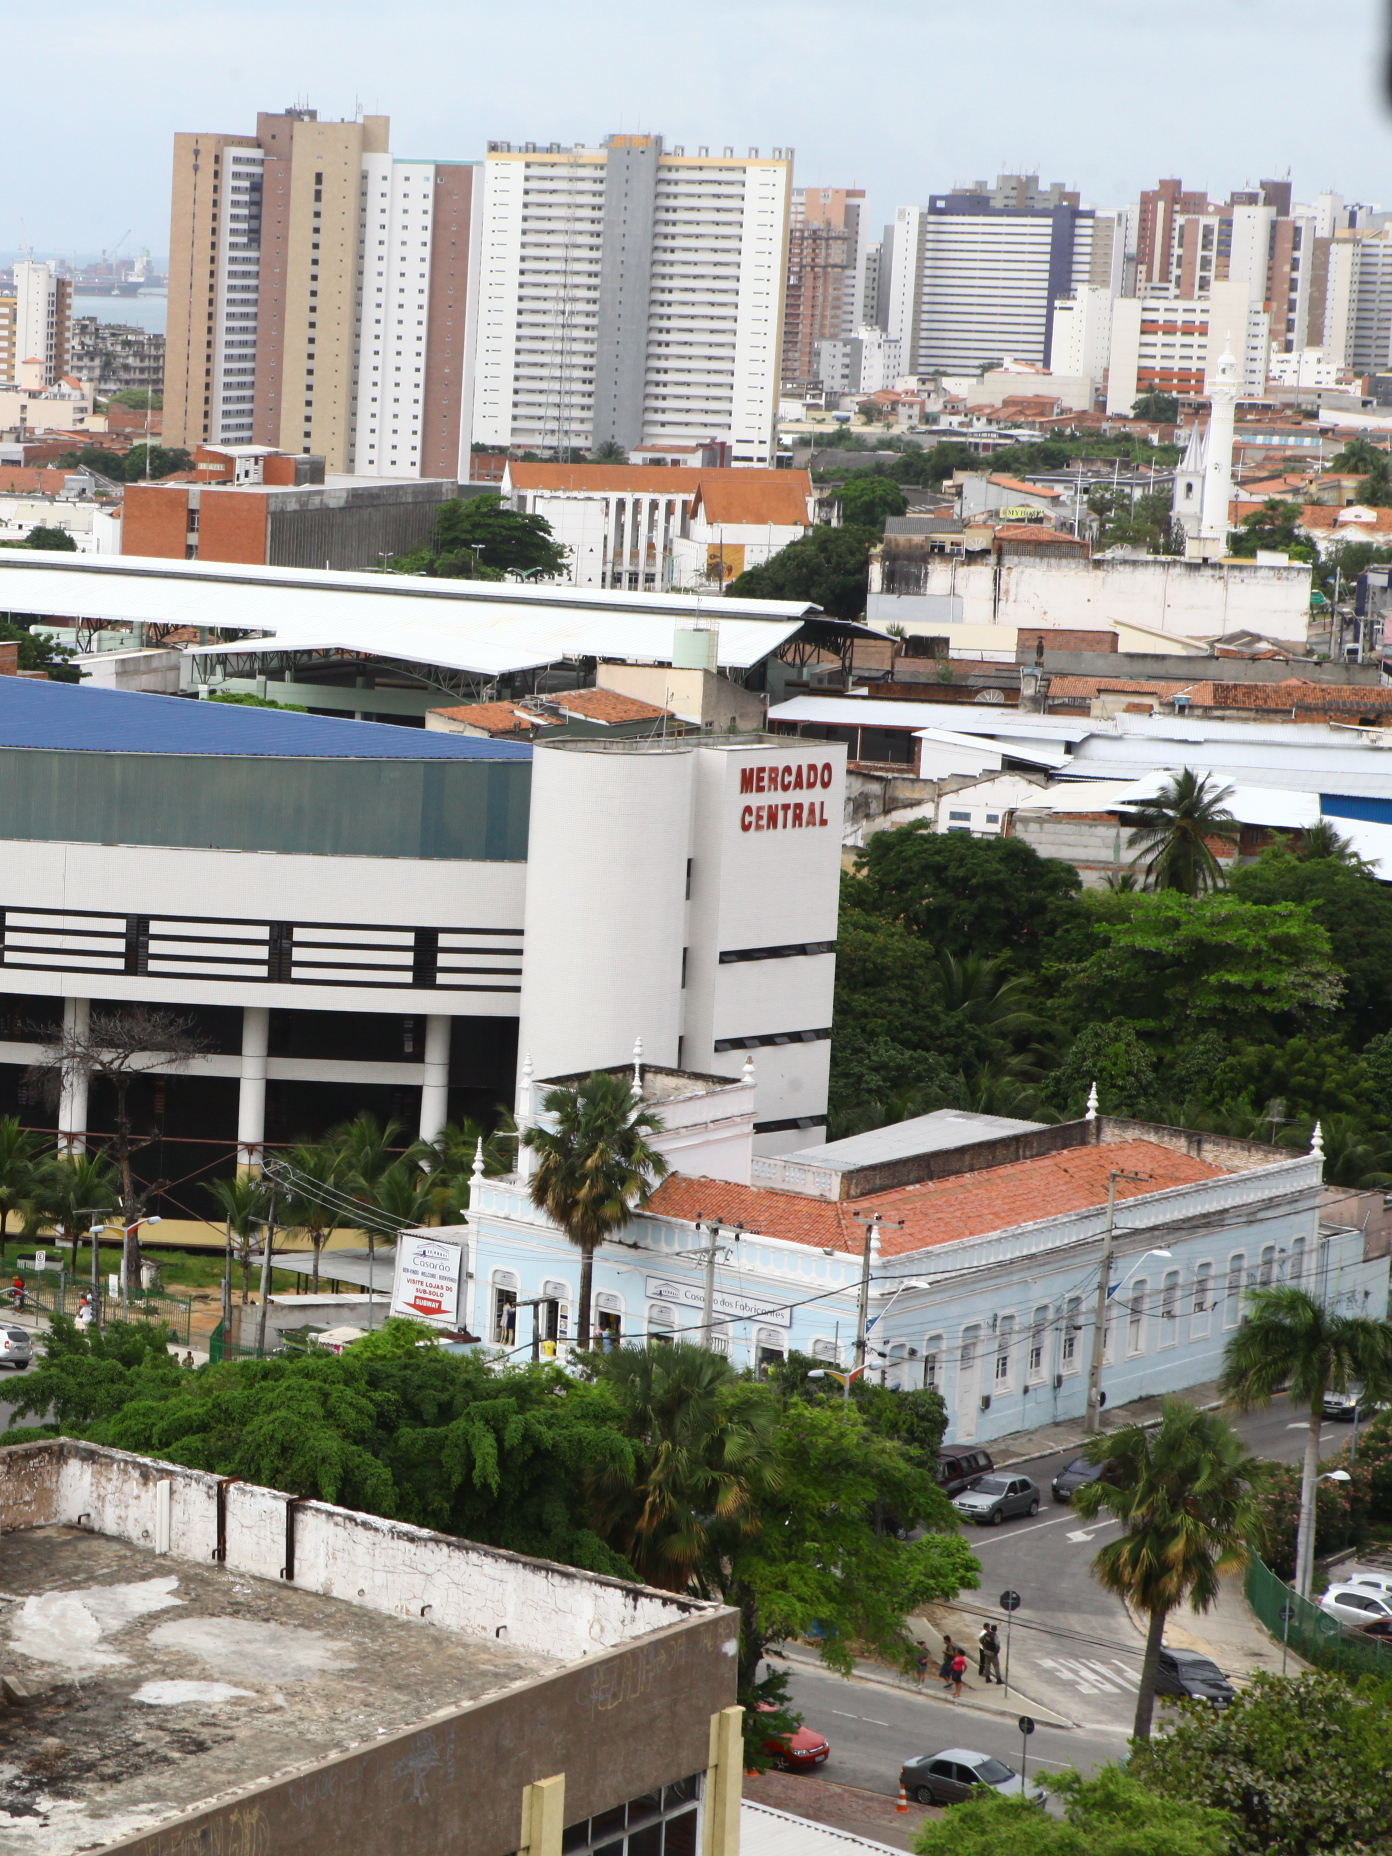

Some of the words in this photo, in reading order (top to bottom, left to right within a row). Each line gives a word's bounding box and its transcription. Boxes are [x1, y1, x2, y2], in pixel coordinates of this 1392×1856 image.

[740, 762, 832, 794] MERCADO
[741, 801, 828, 832] CENTRAL
[413, 1256, 450, 1272] Casarão
[406, 1278, 424, 1286] VISITE
[426, 1282, 444, 1290] LOJAS
[415, 1287, 444, 1298] SUB-SOLO
[415, 1298, 440, 1309] SUBWAY
[684, 1290, 719, 1304] Casao
[720, 1298, 733, 1309] dos
[735, 1300, 785, 1319] Fabricantes
